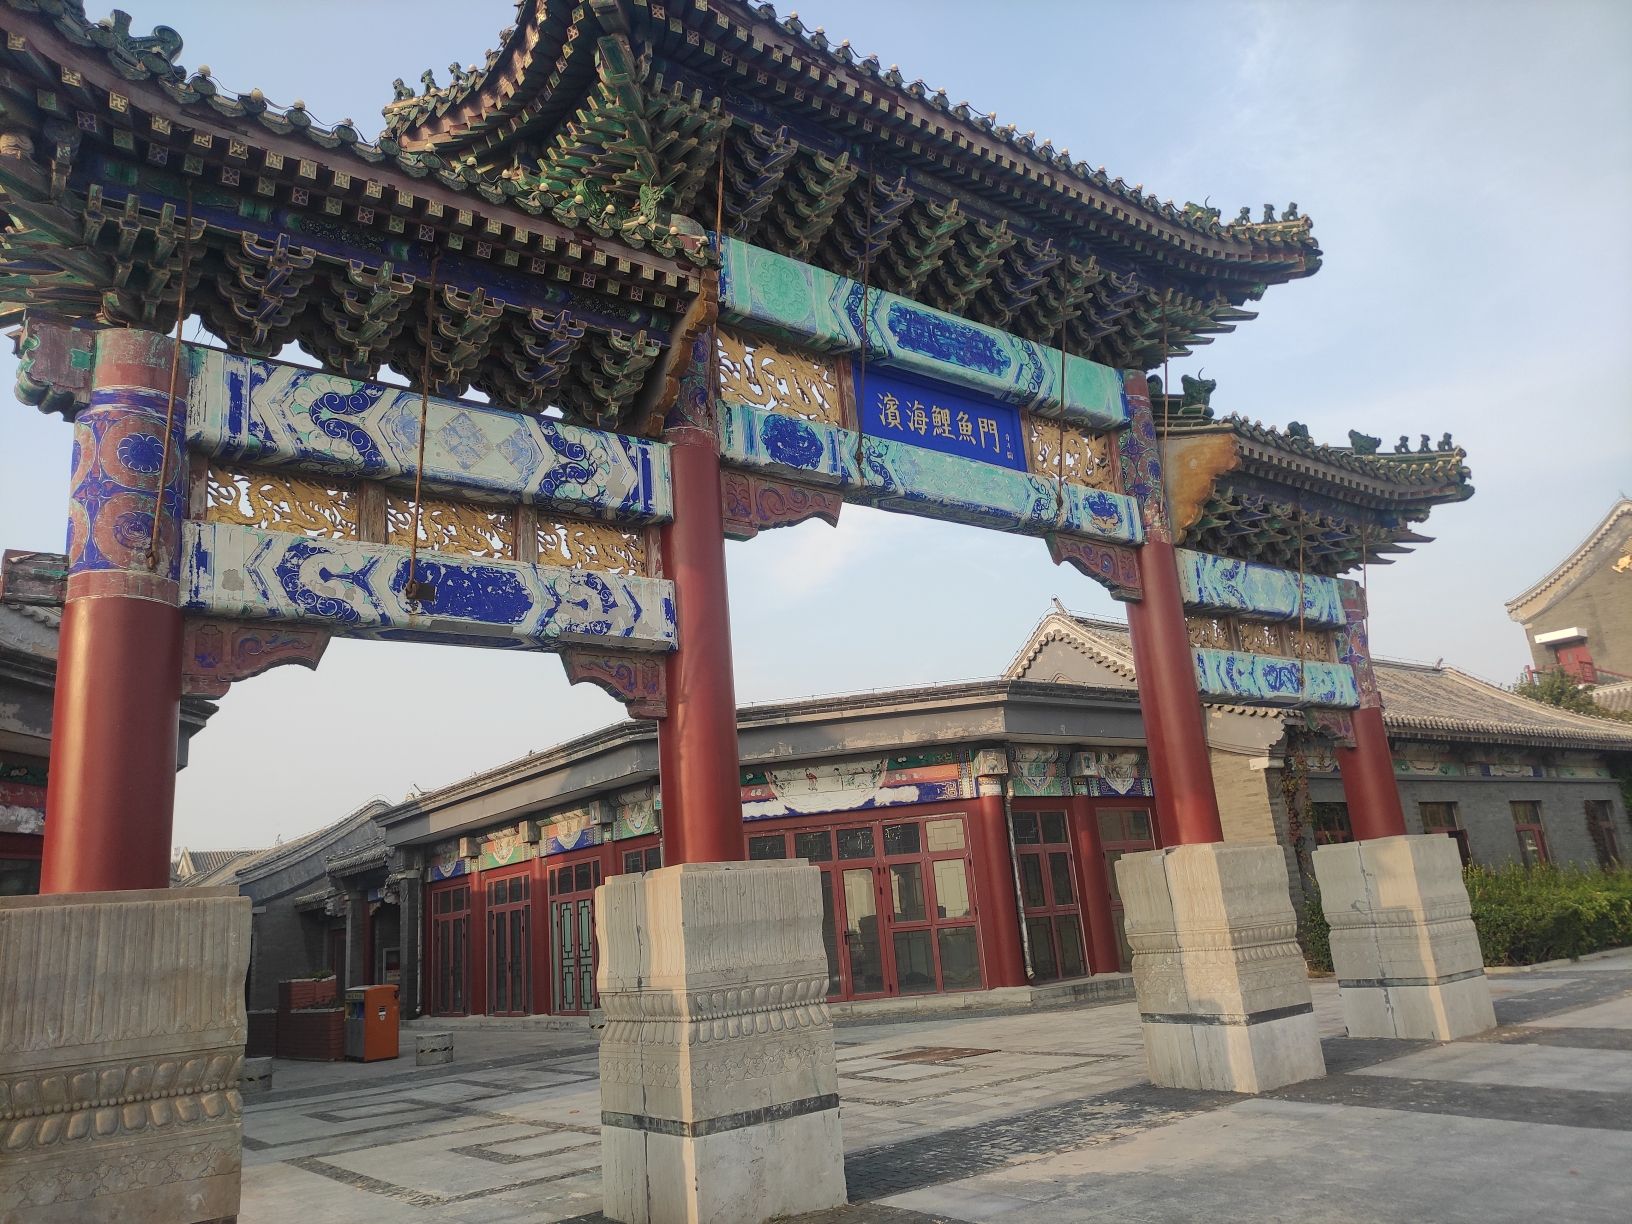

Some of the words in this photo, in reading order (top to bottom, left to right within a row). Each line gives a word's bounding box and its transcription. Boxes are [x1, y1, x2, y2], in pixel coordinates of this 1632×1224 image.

[876, 392, 1000, 453] 濱海鯉魚門
